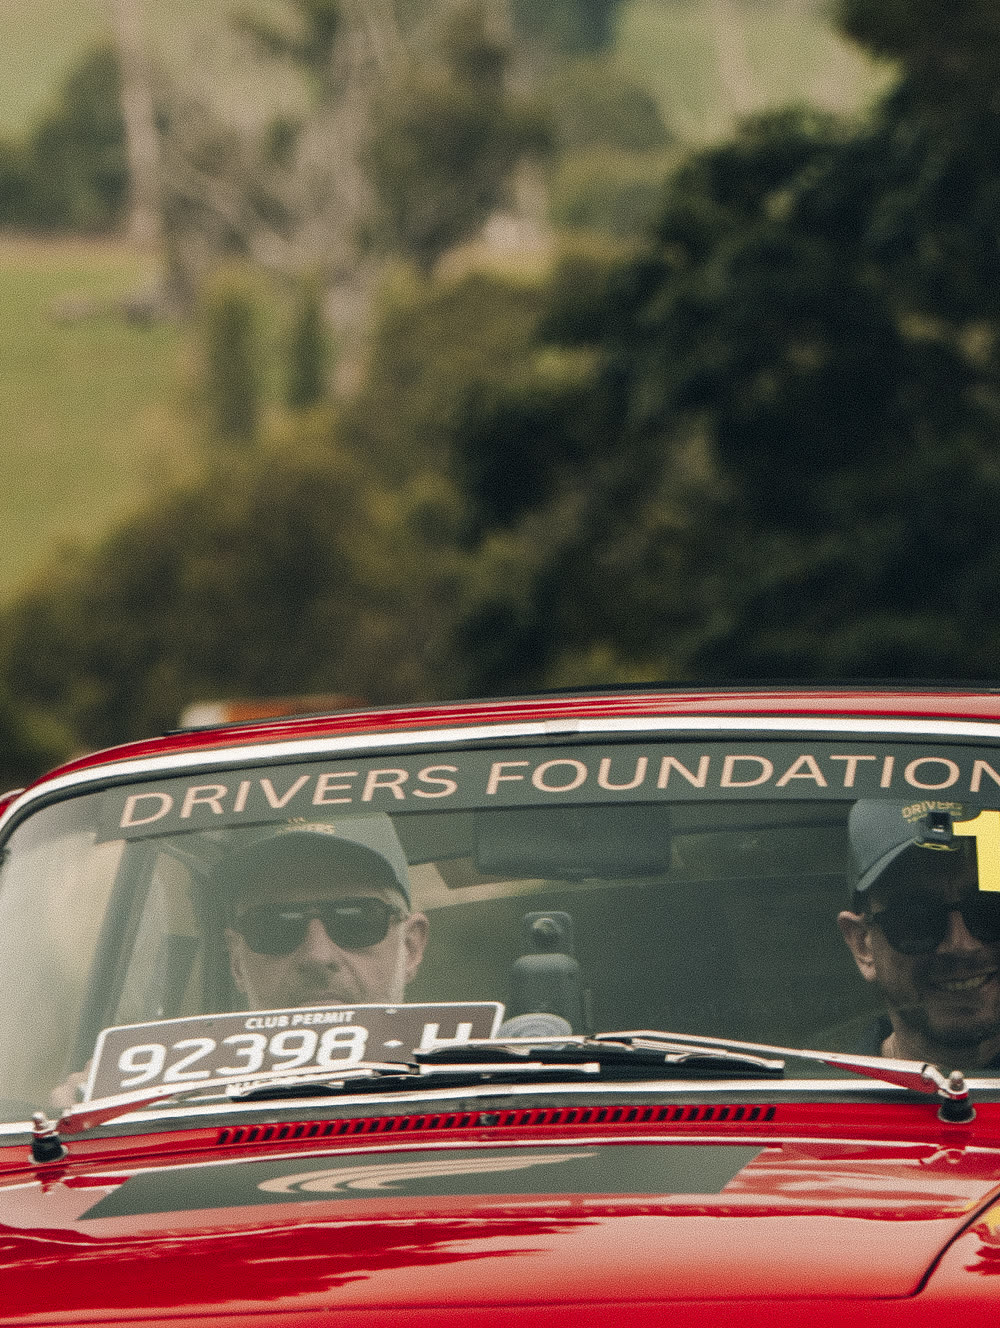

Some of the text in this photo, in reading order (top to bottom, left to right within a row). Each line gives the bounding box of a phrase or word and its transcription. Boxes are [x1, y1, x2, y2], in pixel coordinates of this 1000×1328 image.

[119, 764, 459, 828] DRIVERS
[244, 1010, 356, 1030] CLUB PERMIT
[117, 1025, 369, 1088] 92398
